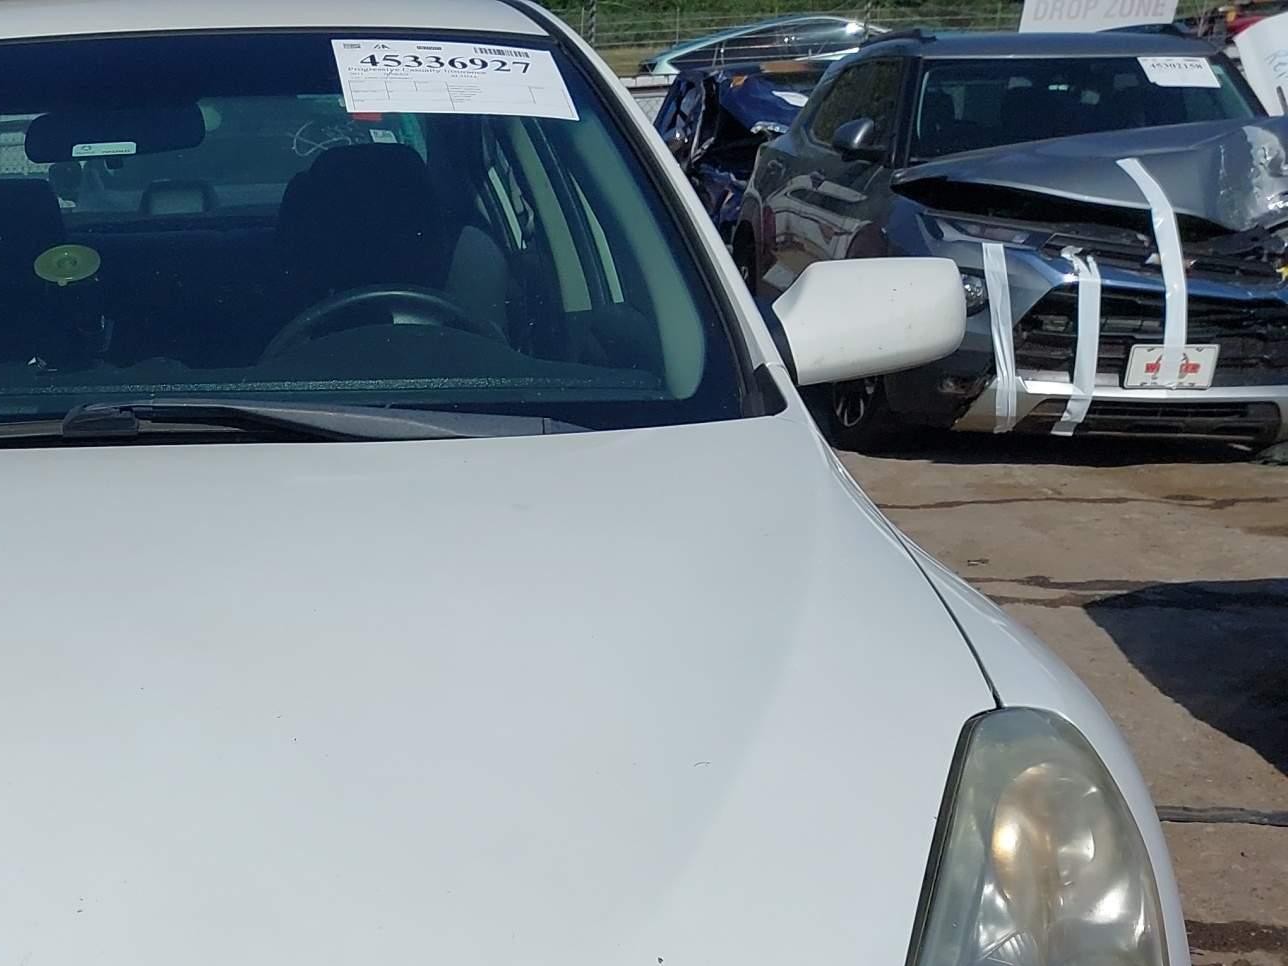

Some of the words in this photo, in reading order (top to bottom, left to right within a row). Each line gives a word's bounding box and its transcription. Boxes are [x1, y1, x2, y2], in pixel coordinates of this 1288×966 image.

[1033, 0, 1097, 21] DROP
[1103, 0, 1166, 19] ZONE
[360, 54, 531, 74] 45336927
